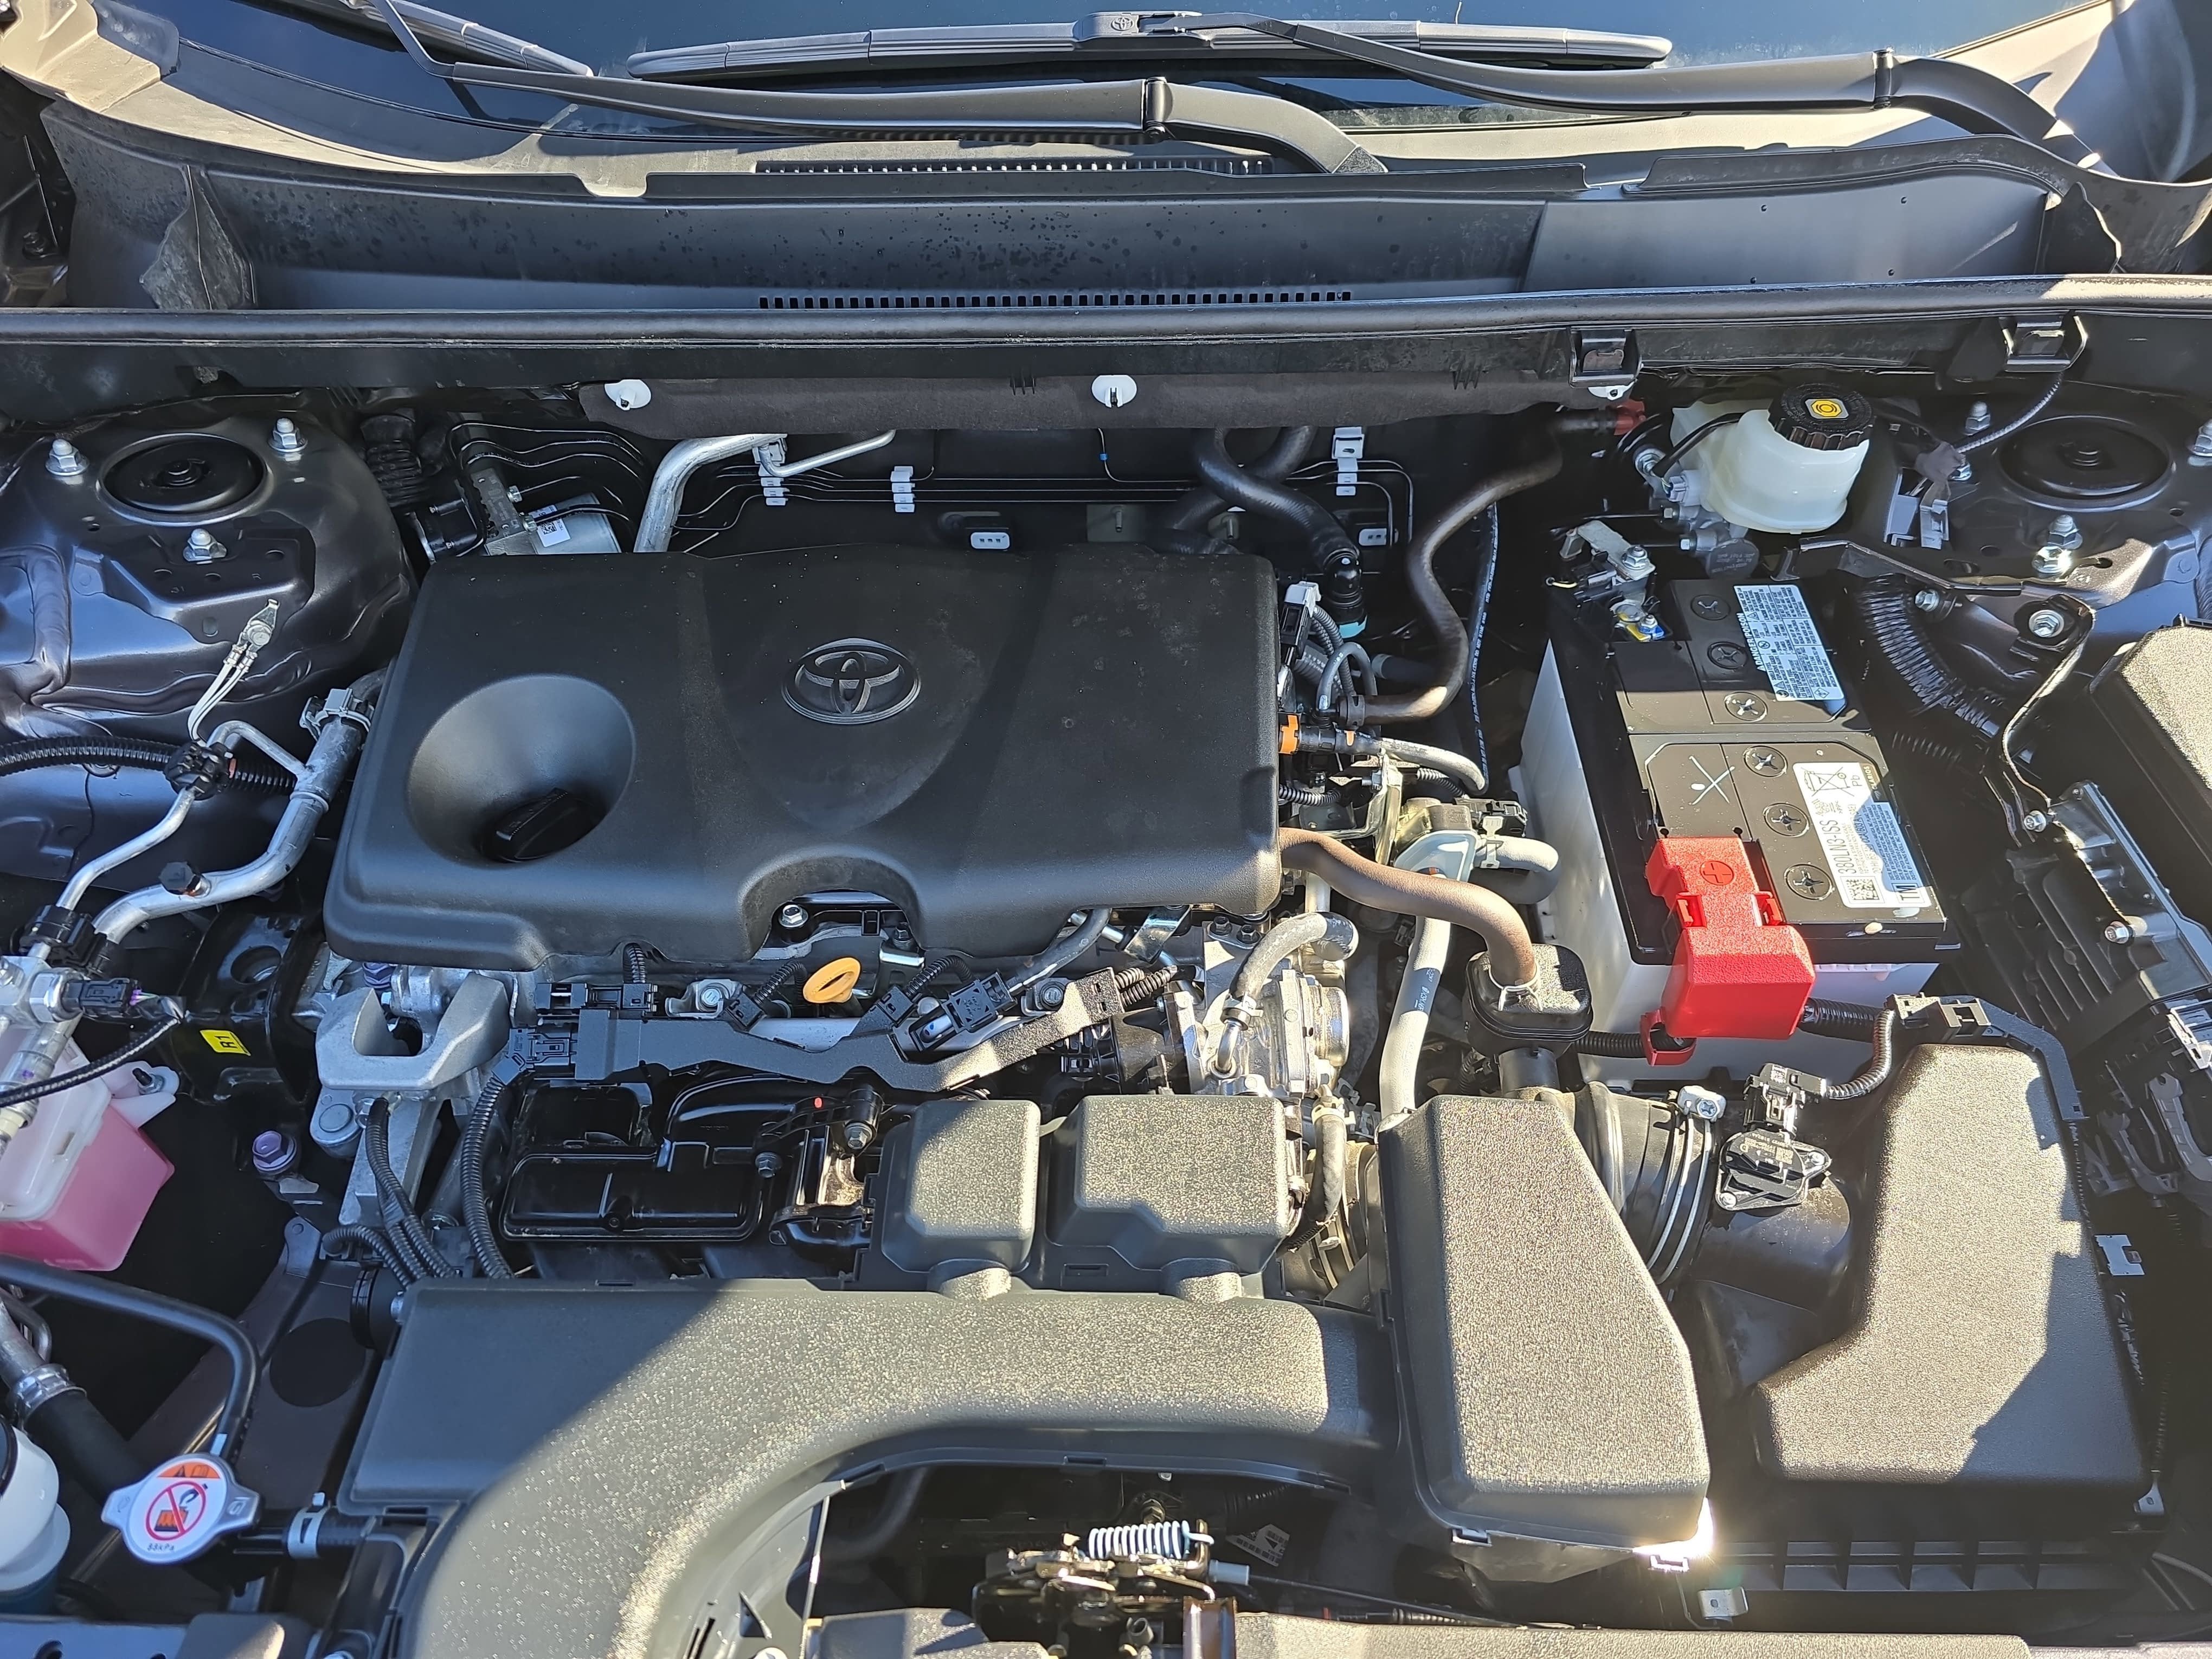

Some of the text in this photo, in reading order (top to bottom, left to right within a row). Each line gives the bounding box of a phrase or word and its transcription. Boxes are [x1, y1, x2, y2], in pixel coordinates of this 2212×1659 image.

[1735, 613, 1764, 665] DANGER/POISON
[1848, 775, 1863, 786] Pb
[1862, 766, 1879, 789] CLARIOS
[1854, 822, 1866, 831] 603
[1858, 832, 1870, 843] CCA
[1818, 819, 1857, 874] 380LN3-ISS
[1895, 884, 1921, 901] TM
[214, 1035, 237, 1049] R1
